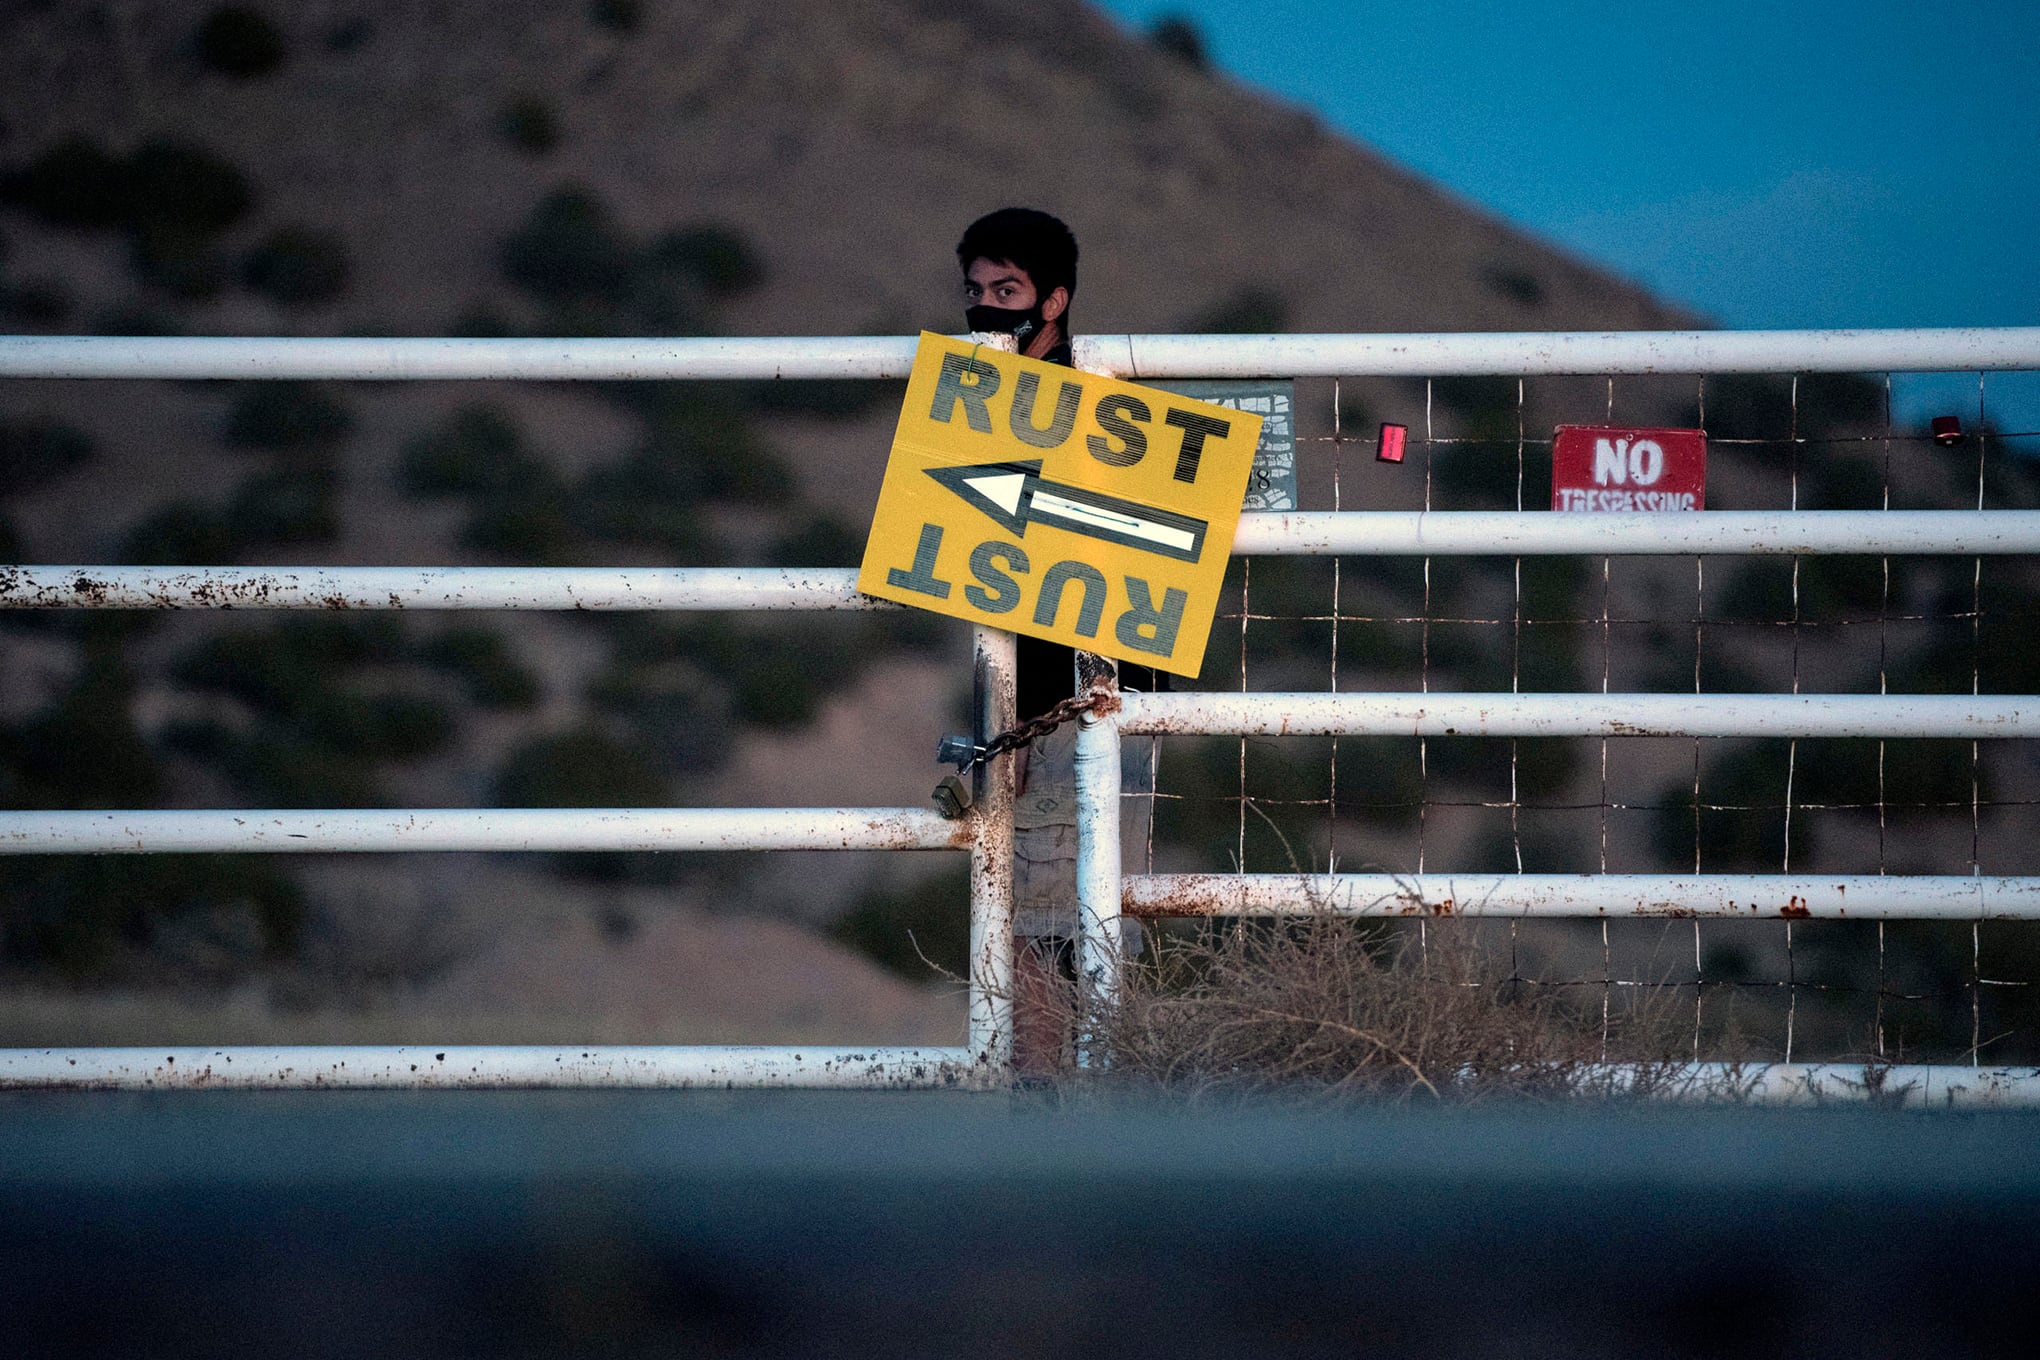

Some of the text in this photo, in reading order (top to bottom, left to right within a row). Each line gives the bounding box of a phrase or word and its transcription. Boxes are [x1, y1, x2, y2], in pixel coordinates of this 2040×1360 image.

[929, 351, 1231, 484] RUST
[1594, 438, 1664, 487] NO
[1560, 488, 1695, 512] TRESPASSING
[886, 522, 1188, 659] RUST
